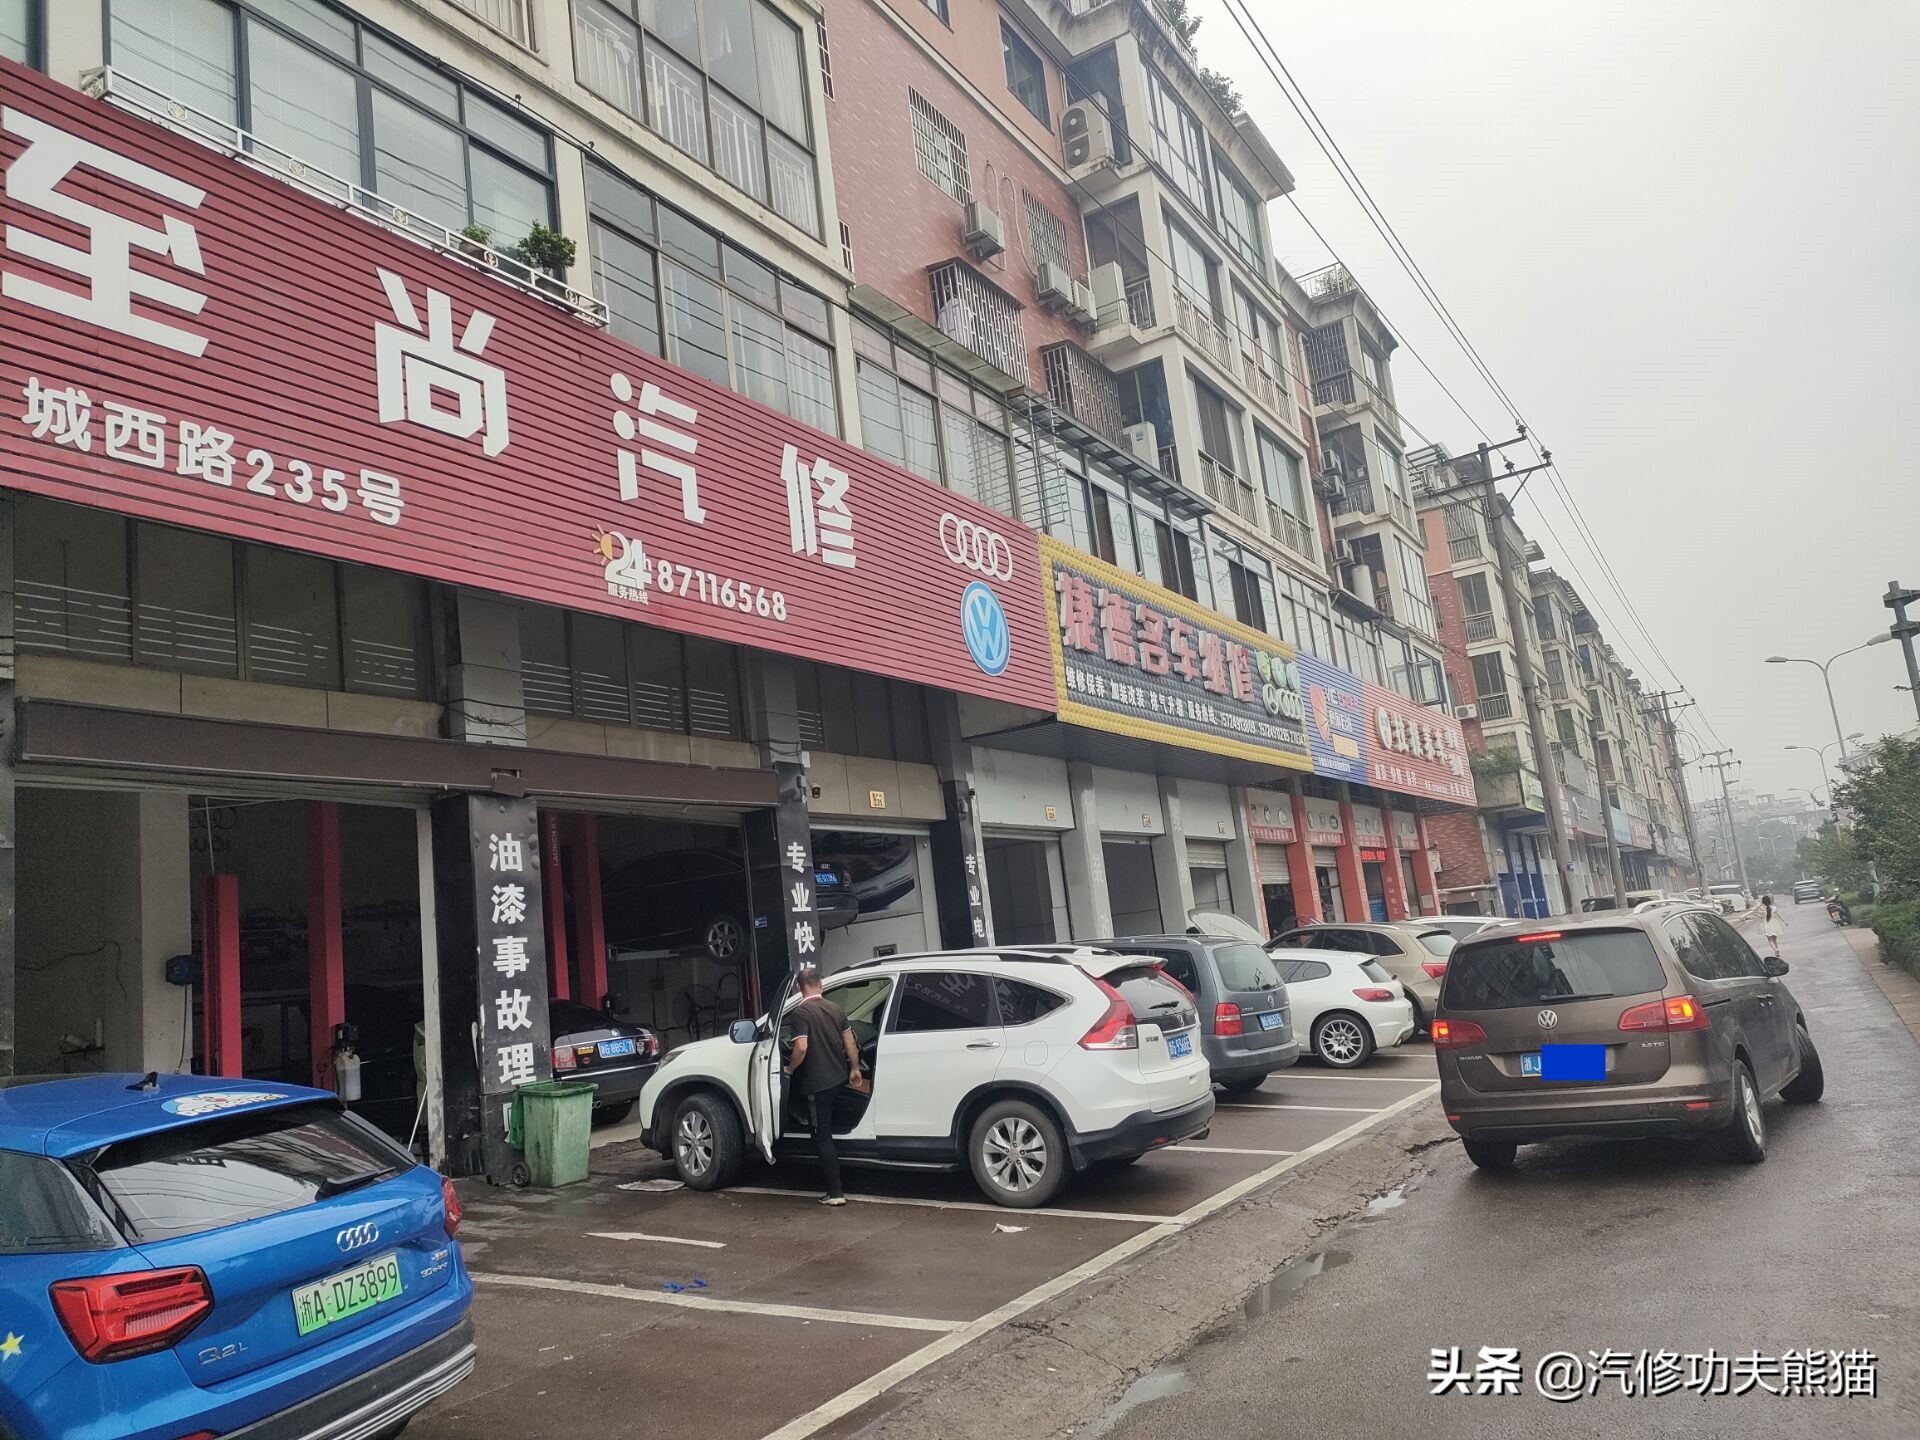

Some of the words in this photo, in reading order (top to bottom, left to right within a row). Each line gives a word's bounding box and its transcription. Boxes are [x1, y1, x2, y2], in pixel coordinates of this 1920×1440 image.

[2, 105, 857, 568] 至尚汽修
[22, 377, 405, 526] 城西路235号
[607, 582, 649, 606] 服务热线
[657, 559, 787, 621] 87116568
[488, 832, 537, 1144] 油漆事故理
